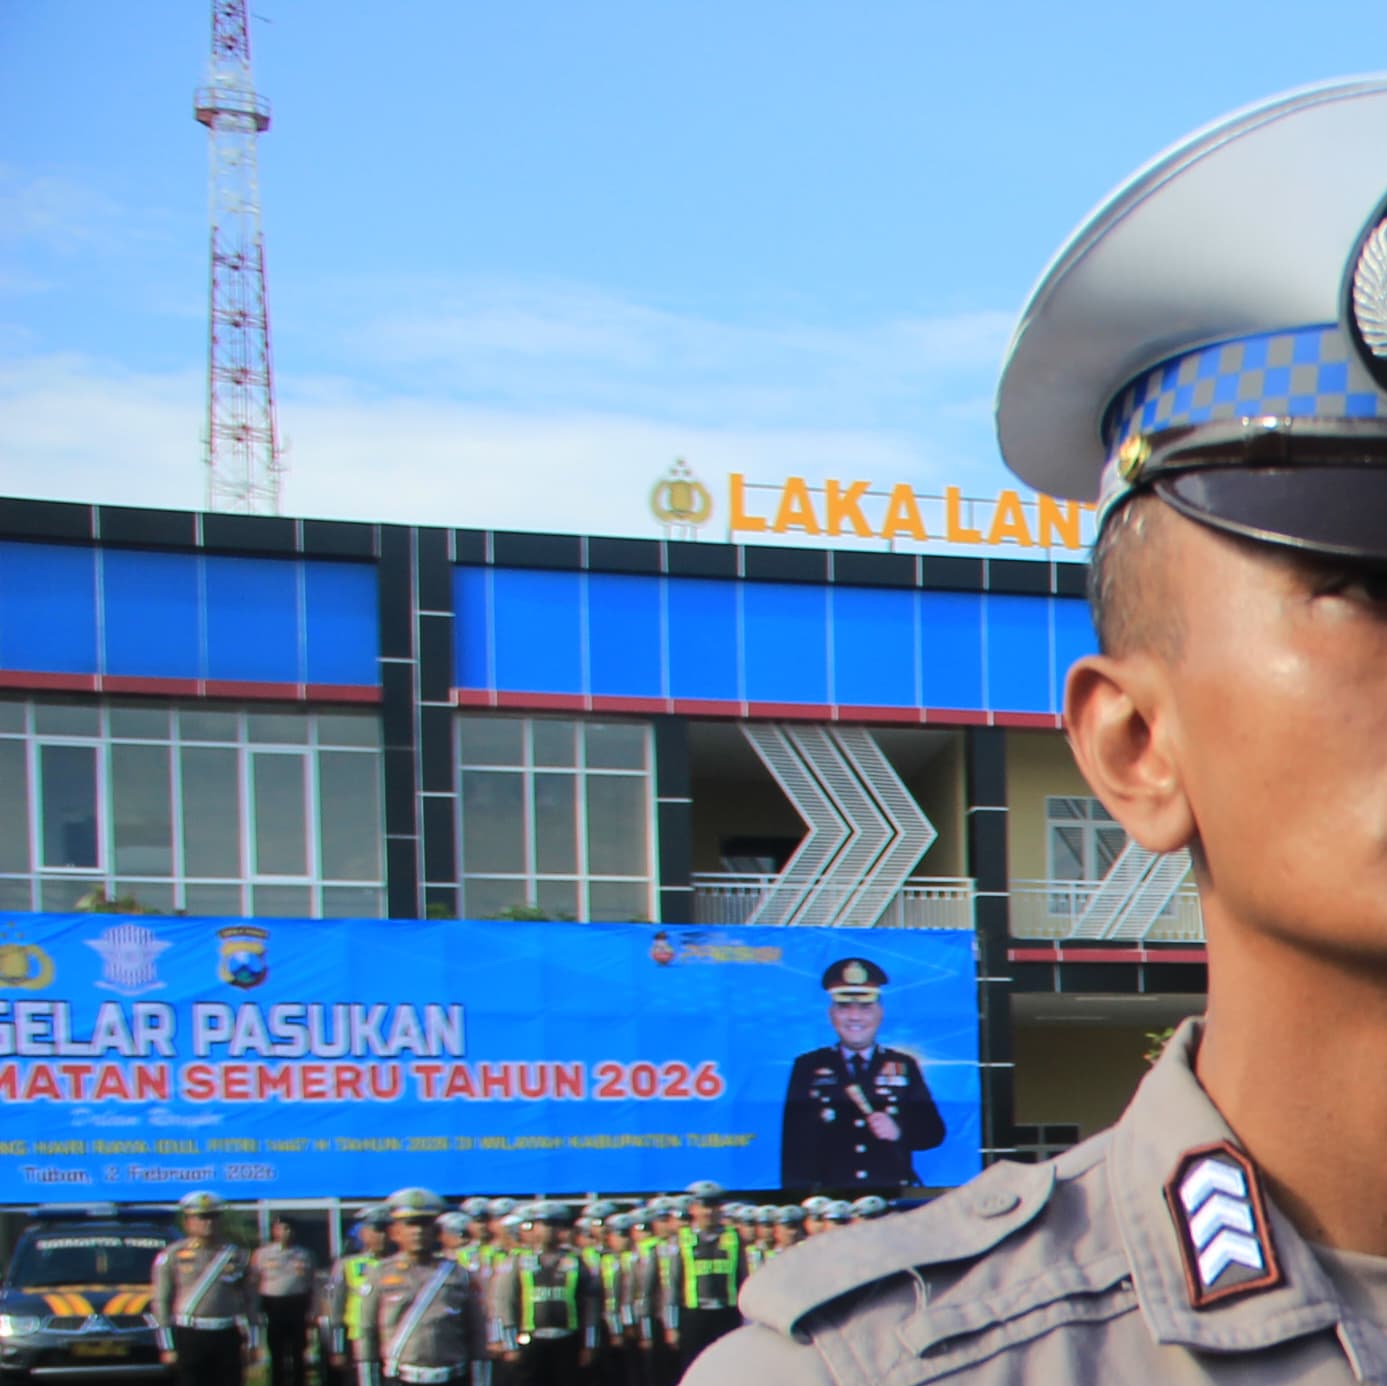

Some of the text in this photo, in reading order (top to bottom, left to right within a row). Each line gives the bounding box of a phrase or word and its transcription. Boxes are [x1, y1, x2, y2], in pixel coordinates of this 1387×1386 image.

[730, 472, 928, 542] LAKA
[192, 1001, 465, 1058] PASUKAN
[184, 1063, 400, 1100] SEMERU
[414, 1063, 584, 1099] TAHUN
[599, 1062, 723, 1099] 2026
